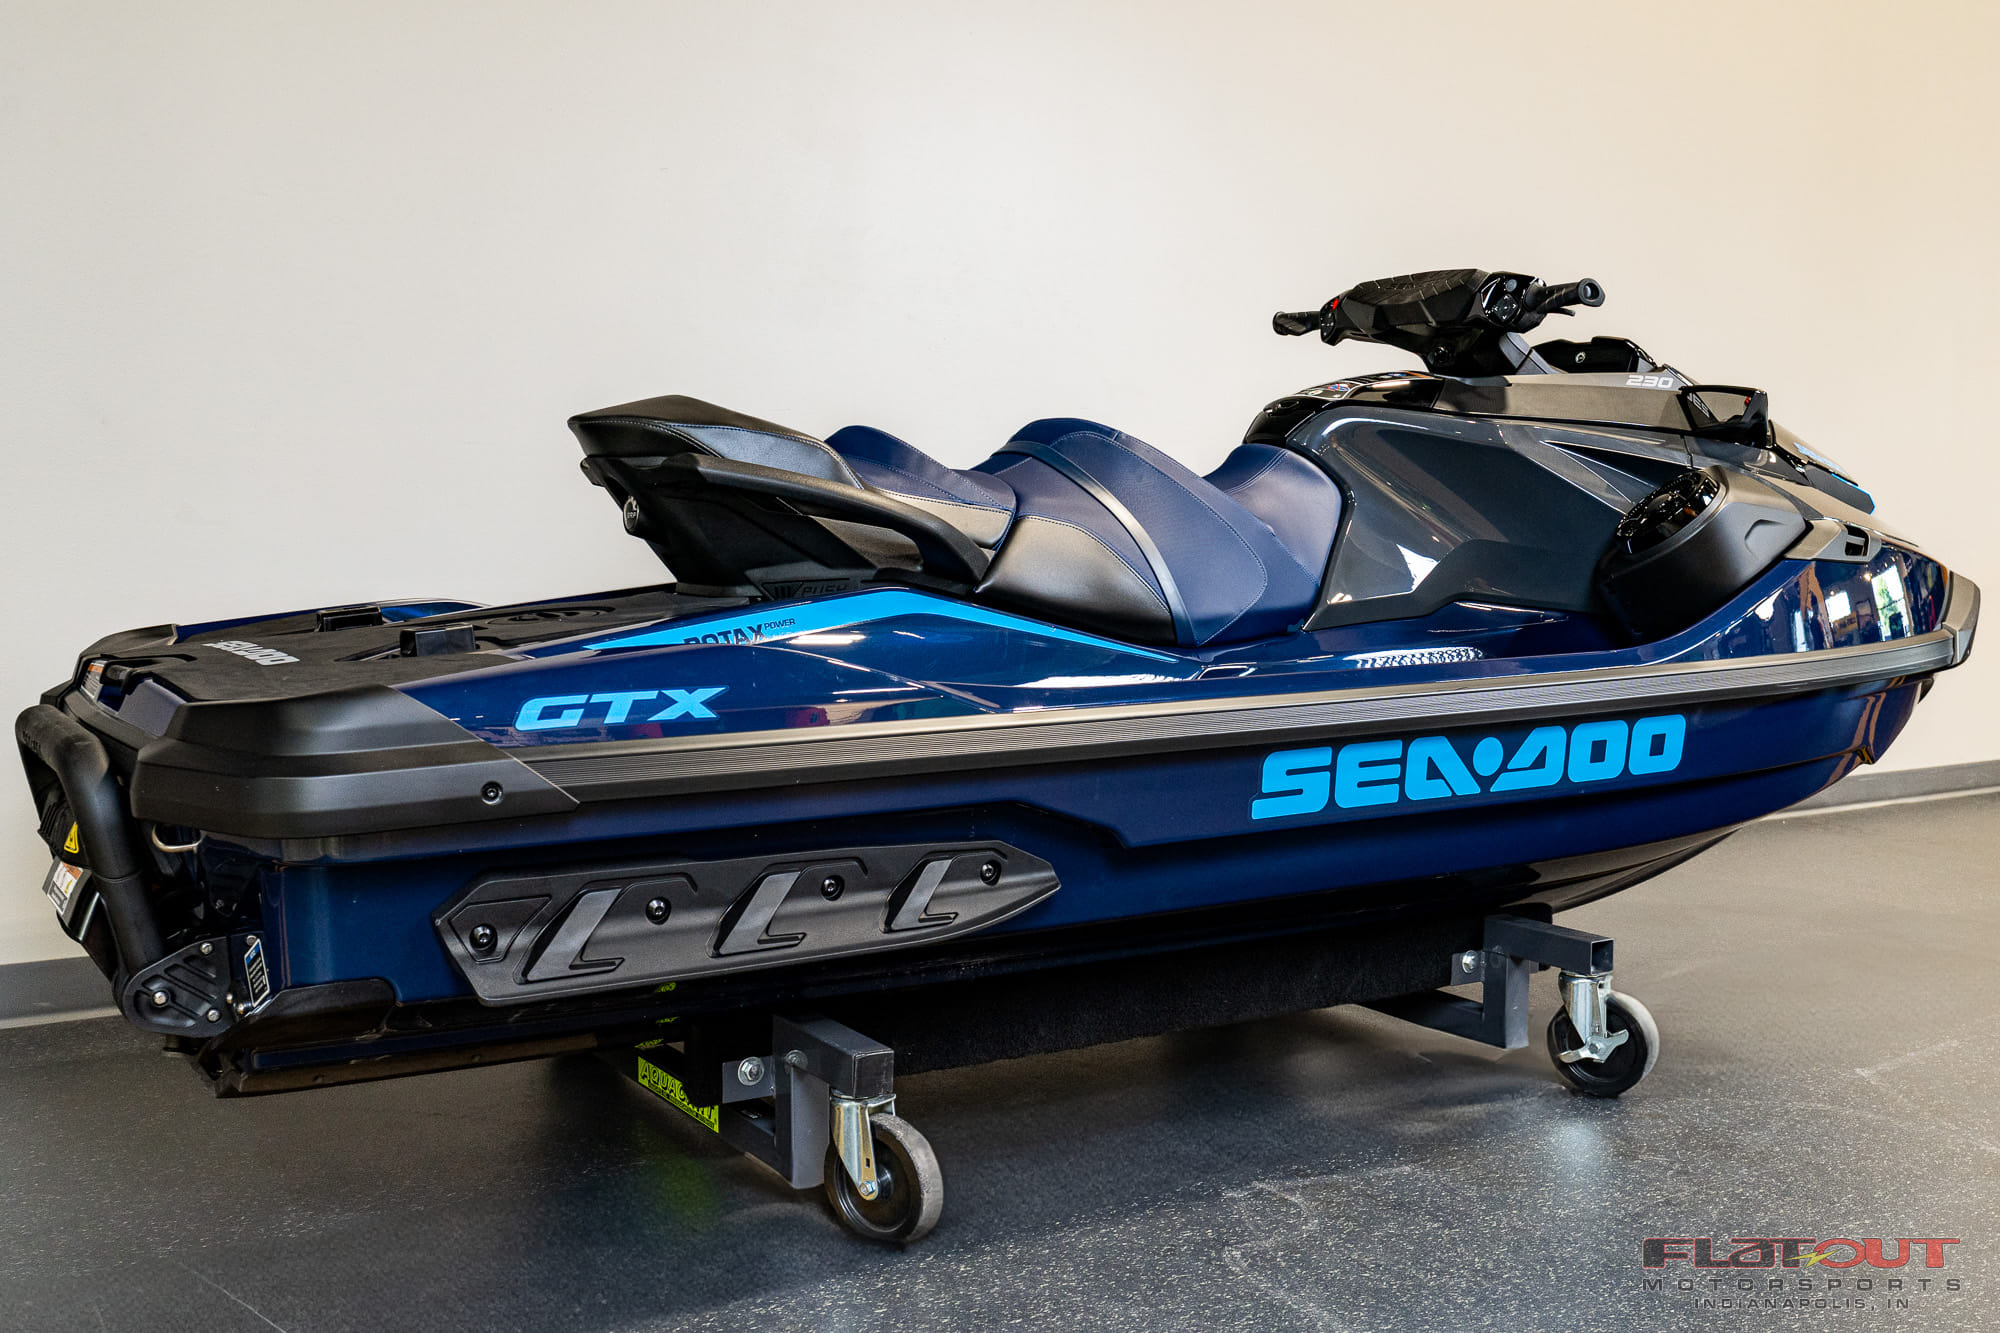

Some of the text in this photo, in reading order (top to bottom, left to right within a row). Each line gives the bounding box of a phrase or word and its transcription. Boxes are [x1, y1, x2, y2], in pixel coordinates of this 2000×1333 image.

[1626, 374, 1674, 389] 230
[763, 618, 796, 630] POWER
[515, 687, 727, 731] GTX
